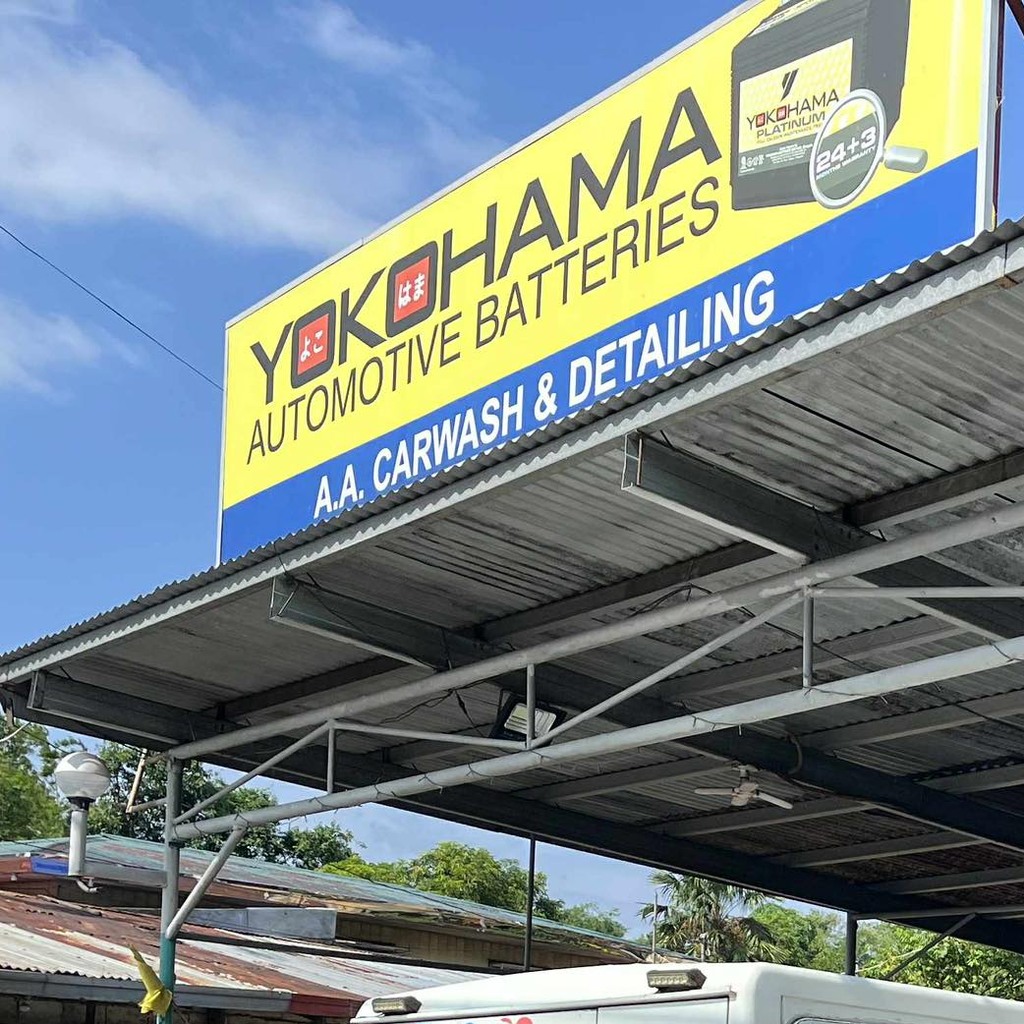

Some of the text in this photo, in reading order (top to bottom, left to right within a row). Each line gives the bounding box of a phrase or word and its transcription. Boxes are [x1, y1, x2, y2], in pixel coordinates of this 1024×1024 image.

[746, 88, 840, 131] YOKOHAMA
[756, 110, 826, 139] PLATINUM
[815, 125, 877, 174] 24+3
[250, 86, 723, 406] YOKOHAMA
[397, 272, 426, 309] はま
[246, 175, 720, 465] AUTOMOTIVE BATTERIES
[300, 329, 324, 362] よこ
[313, 269, 776, 519] A.A. CARWASH & DETAILING
